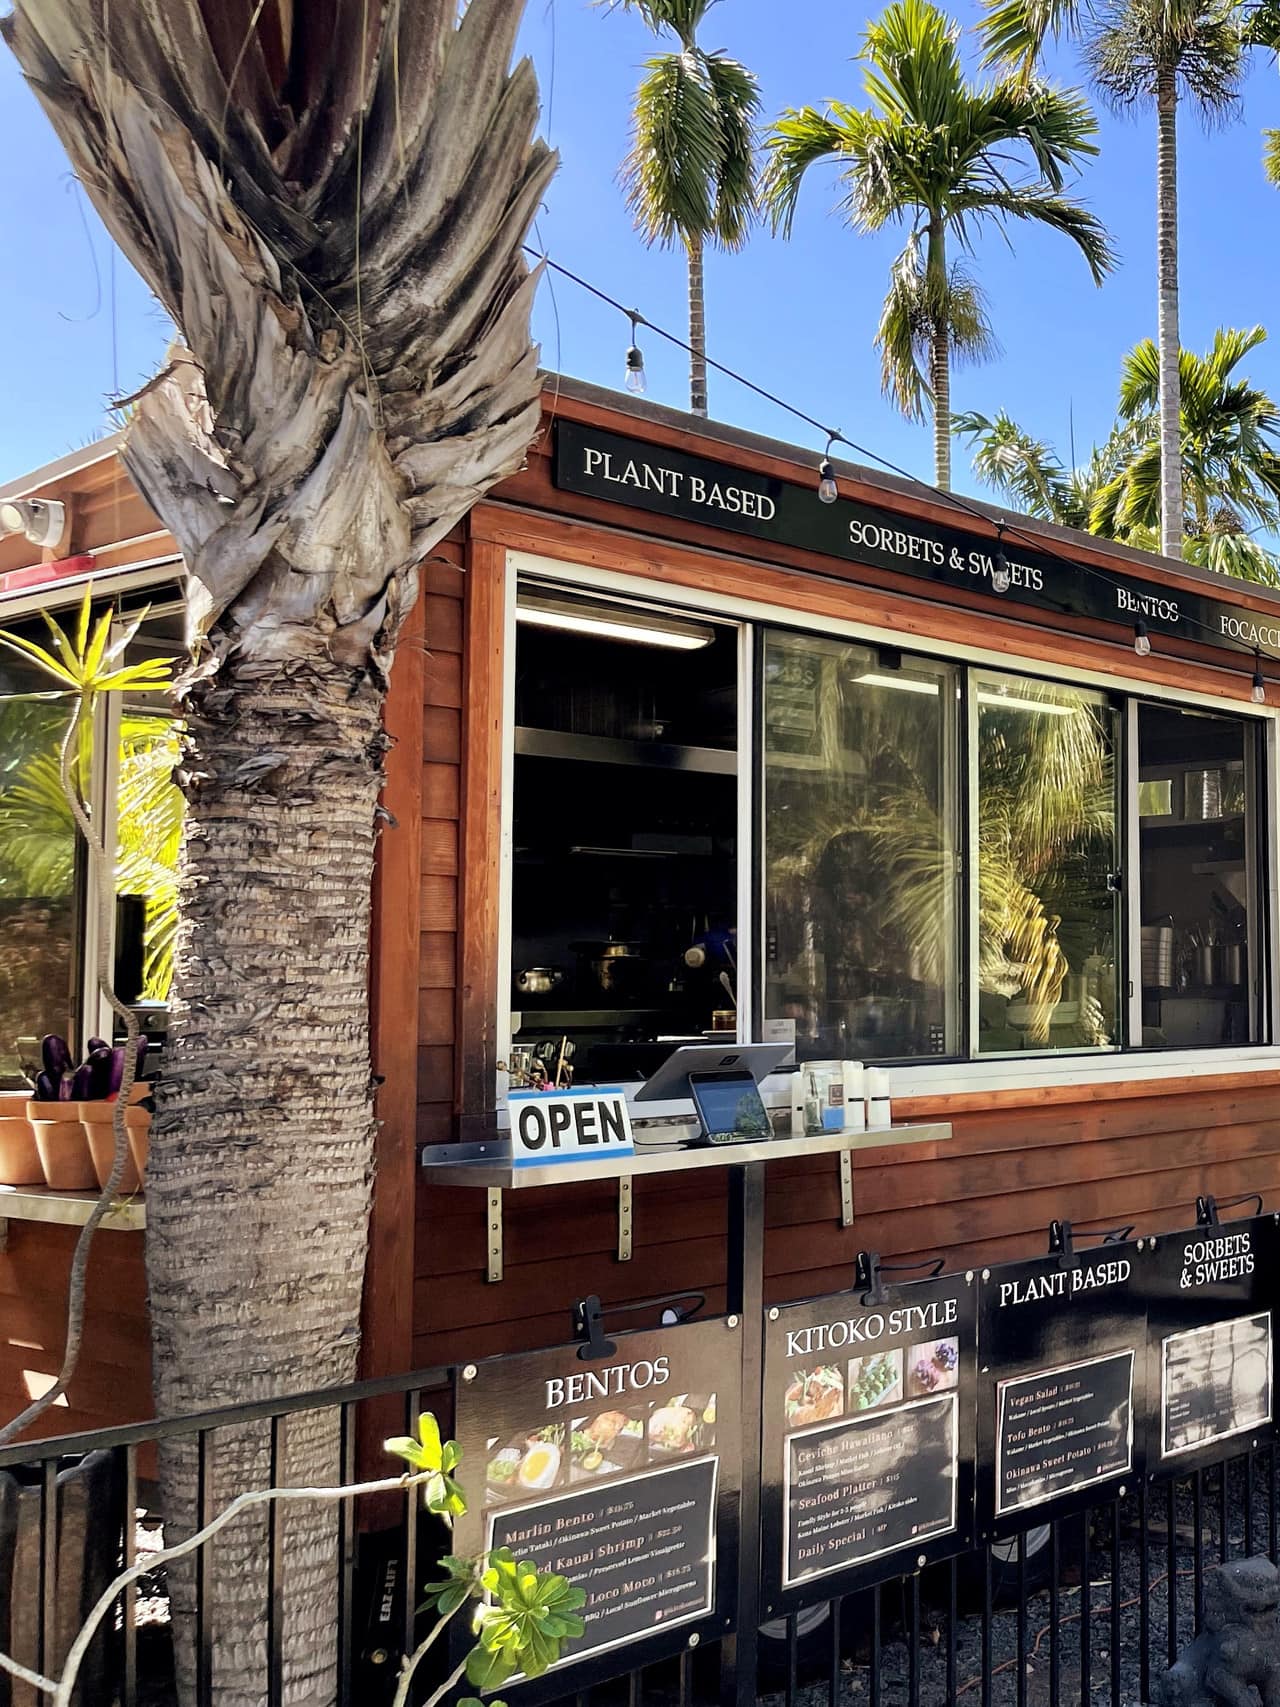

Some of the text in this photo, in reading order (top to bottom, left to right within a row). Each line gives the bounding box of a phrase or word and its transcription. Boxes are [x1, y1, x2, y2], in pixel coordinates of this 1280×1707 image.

[583, 447, 776, 521] PLANT BASED
[849, 520, 945, 565] SORBETS
[949, 545, 965, 571] &
[1117, 588, 1179, 622] BENTOS
[518, 1099, 626, 1151] OPEN
[1183, 1232, 1251, 1266] SORBETS
[999, 1259, 1132, 1308] PLANT BASED
[1179, 1253, 1255, 1289] & SWEETS
[785, 1298, 958, 1359] KITOKO STYLE
[545, 1357, 671, 1409] BENTOS
[1009, 1386, 1057, 1408] Vegan Salad
[1007, 1422, 1051, 1443] Tofu Bento
[1006, 1445, 1090, 1480] Okinawa Sweet Potato
[799, 1488, 839, 1509] Seafood
[843, 1477, 876, 1496] Platter
[505, 1521, 551, 1544] Marlin
[556, 1508, 594, 1530] Bento
[556, 1549, 594, 1570] Kauai
[597, 1534, 644, 1559] Shrimp
[798, 1541, 825, 1562] Daily
[828, 1528, 865, 1552] Special
[589, 1585, 619, 1605] Loco
[623, 1574, 655, 1594] Moco
